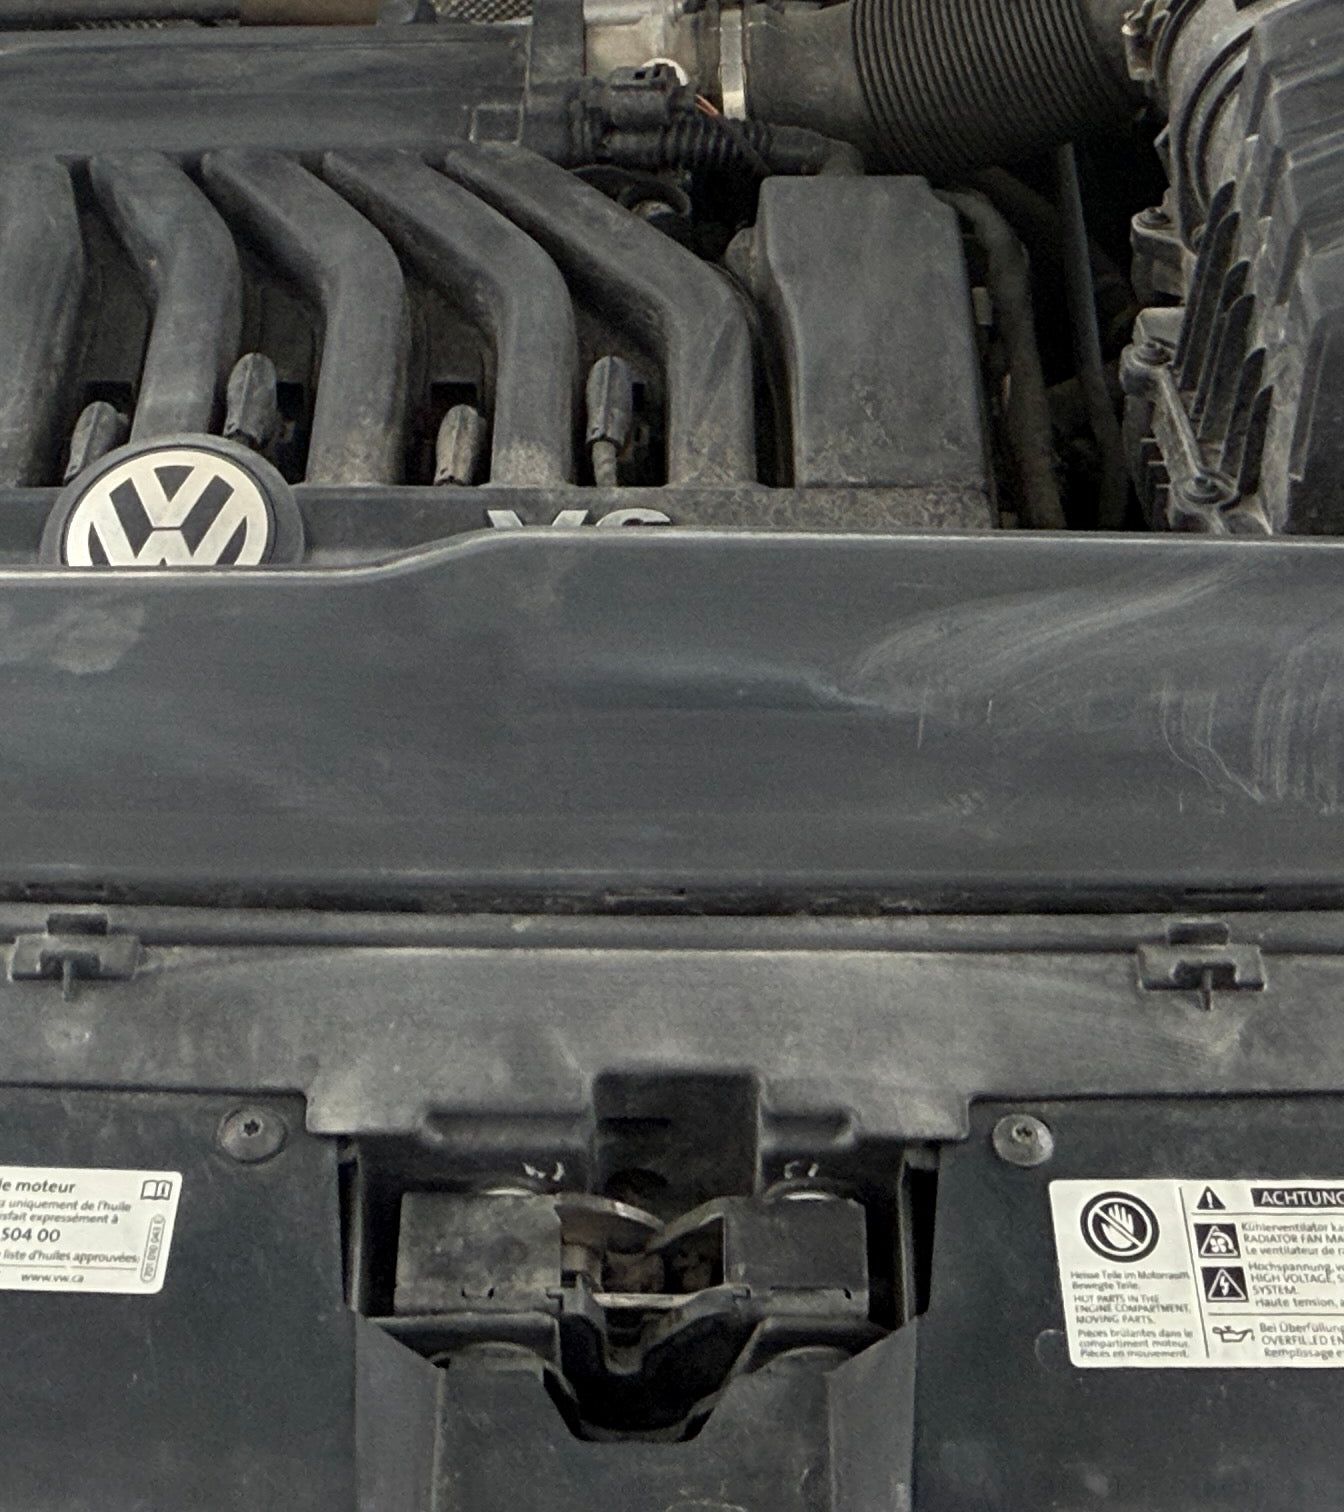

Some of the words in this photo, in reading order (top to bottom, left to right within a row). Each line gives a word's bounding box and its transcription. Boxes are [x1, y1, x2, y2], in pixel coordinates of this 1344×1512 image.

[15, 1181, 76, 1193] moteur
[9, 1199, 77, 1211] uniquement
[81, 1200, 94, 1210] de
[98, 1200, 131, 1211] l'huile
[30, 1212, 108, 1225] expressément
[1, 1228, 32, 1241] 504
[37, 1229, 60, 1242] 00
[1244, 1234, 1298, 1244] RADIATOR
[1301, 1235, 1322, 1244] FAN
[4, 1249, 26, 1260] liste
[29, 1249, 70, 1261] d'huiles
[1246, 1246, 1257, 1255] Le
[1260, 1246, 1319, 1255] ventilateur
[1322, 1246, 1335, 1255] de
[21, 1272, 84, 1283] www.vw.ca
[1251, 1274, 1280, 1283] HIGH
[1259, 1323, 1277, 1332] Bei
[1262, 1336, 1328, 1346] OVERFILLED
[1264, 1348, 1333, 1360] Remplissage
